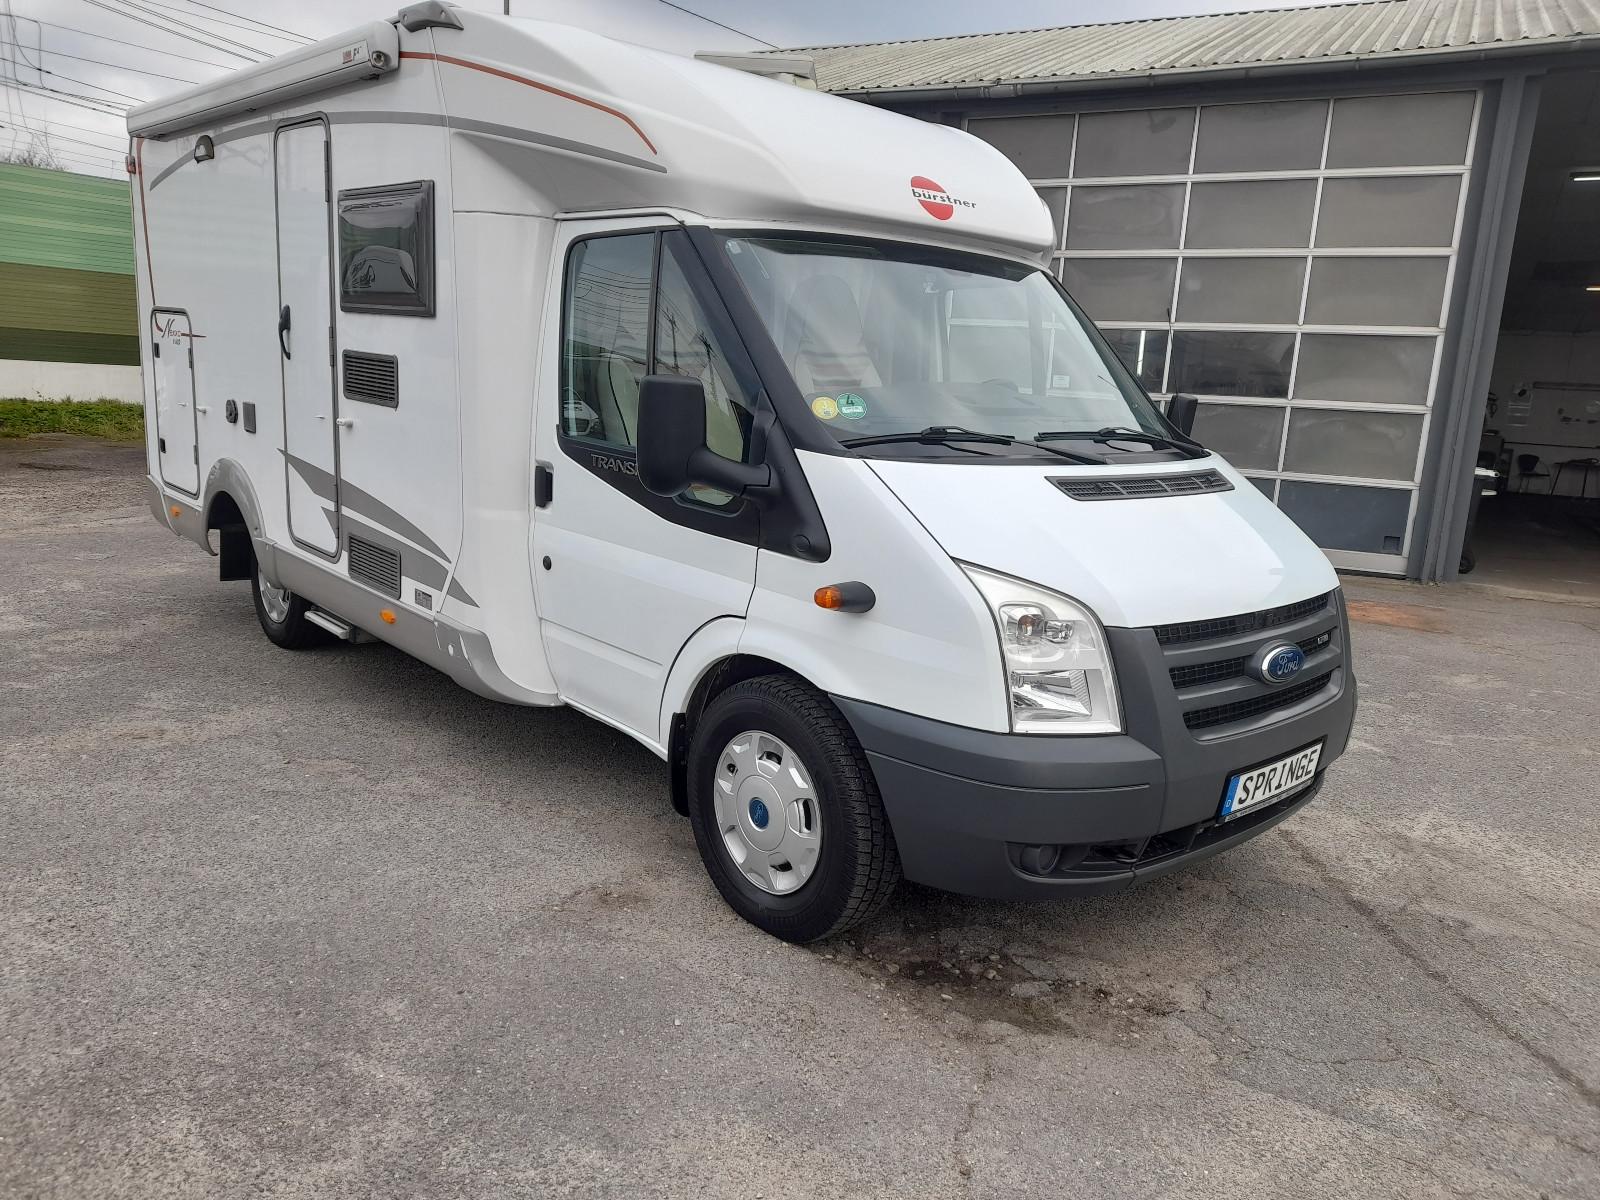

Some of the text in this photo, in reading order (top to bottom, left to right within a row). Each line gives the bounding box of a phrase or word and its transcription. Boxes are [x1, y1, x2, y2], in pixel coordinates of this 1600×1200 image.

[911, 188, 977, 209] bürstner
[846, 394, 855, 406] 4
[590, 453, 639, 476] TRANSI
[1277, 653, 1300, 675] Ford
[1238, 748, 1318, 805] SPRINGE
